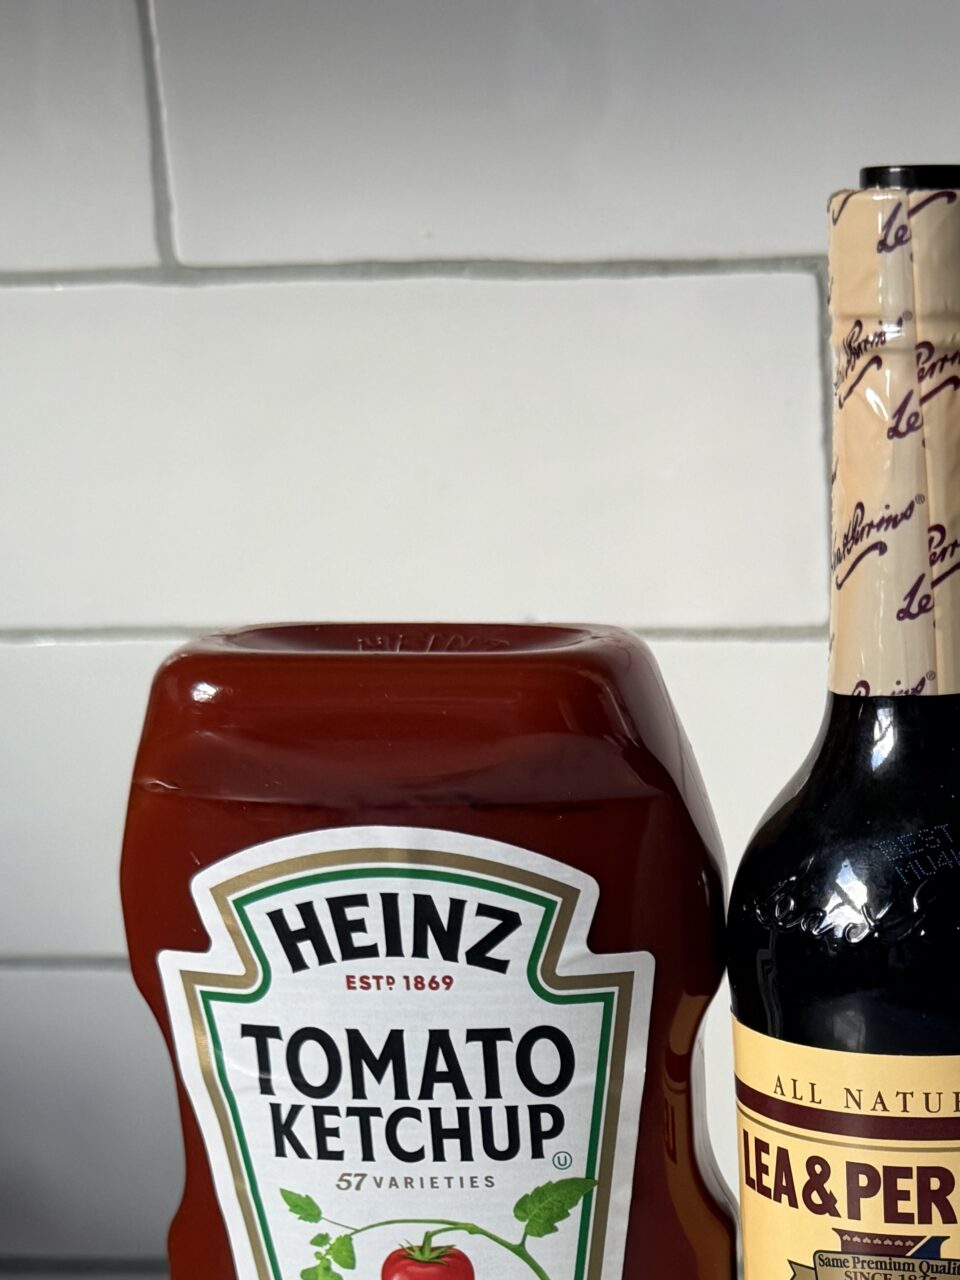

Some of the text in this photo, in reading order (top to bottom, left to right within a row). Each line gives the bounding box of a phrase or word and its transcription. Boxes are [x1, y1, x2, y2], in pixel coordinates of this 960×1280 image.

[875, 823, 954, 861] BEST
[267, 893, 522, 974] HEINZ
[402, 974, 454, 991] 1869
[240, 1024, 575, 1100] TOMATO
[773, 1074, 823, 1105] ALL
[269, 1102, 565, 1163] KETCHUP
[336, 1172, 496, 1191] 57 VARIETIES
[818, 1252, 850, 1268] Same
[852, 1255, 917, 1273] Premium
